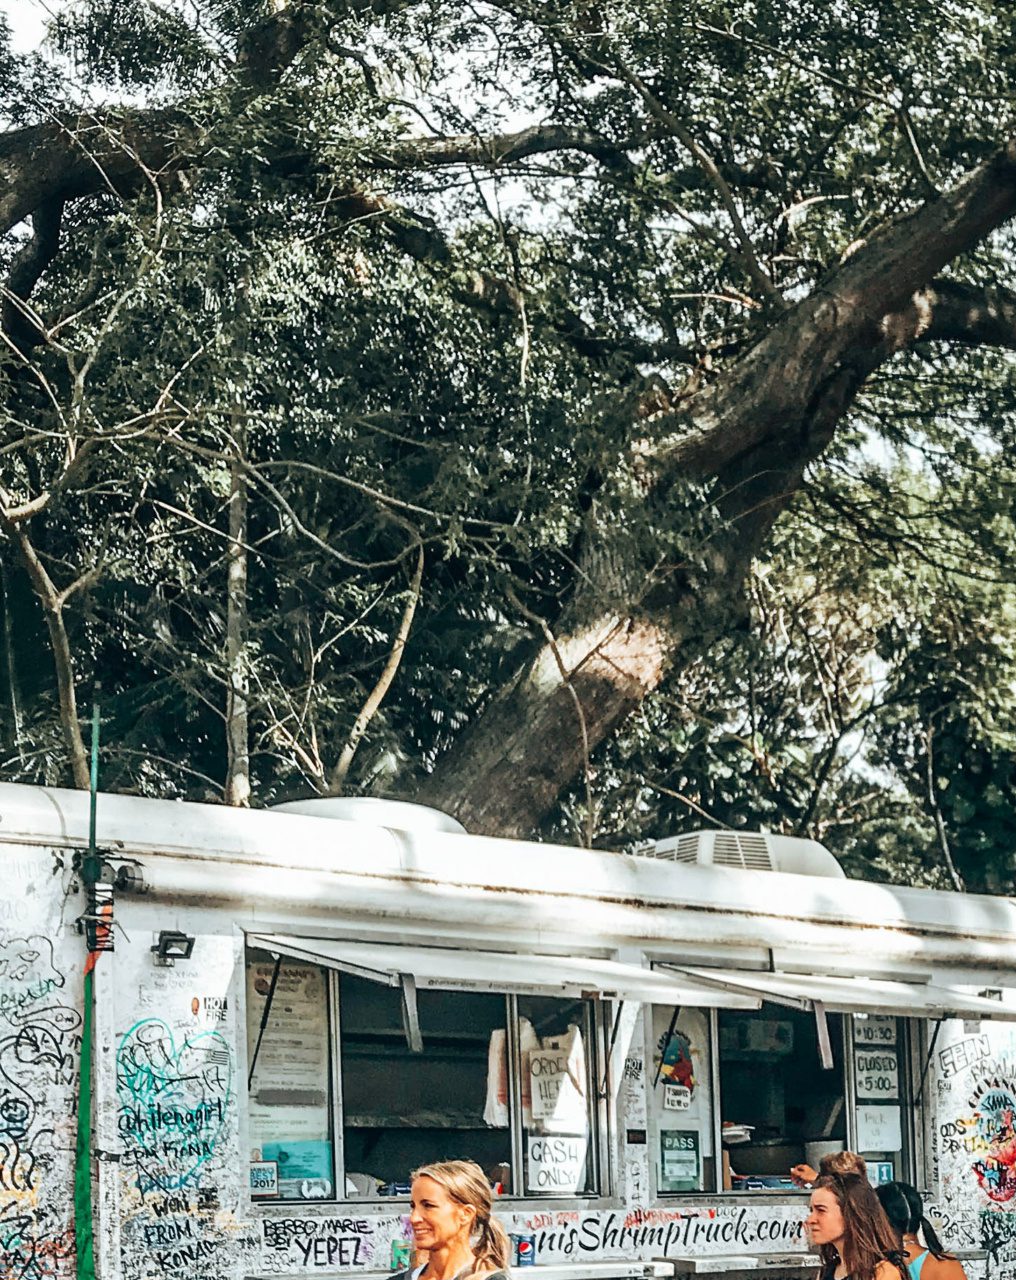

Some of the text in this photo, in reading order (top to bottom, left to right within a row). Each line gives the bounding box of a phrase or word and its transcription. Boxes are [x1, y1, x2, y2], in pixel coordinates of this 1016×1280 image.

[206, 1010, 227, 1021] FIRE
[857, 1055, 897, 1072] CLOSED
[939, 1034, 991, 1079] SEAN
[531, 1140, 579, 1163] CASH
[664, 1137, 695, 1149] PASS
[253, 1179, 276, 1188] 2017
[143, 1219, 193, 1246] FROM
[321, 1218, 374, 1235] MARIE
[534, 1208, 803, 1257] nisShrimpTruck.com
[294, 1236, 365, 1266] YEPEZ
